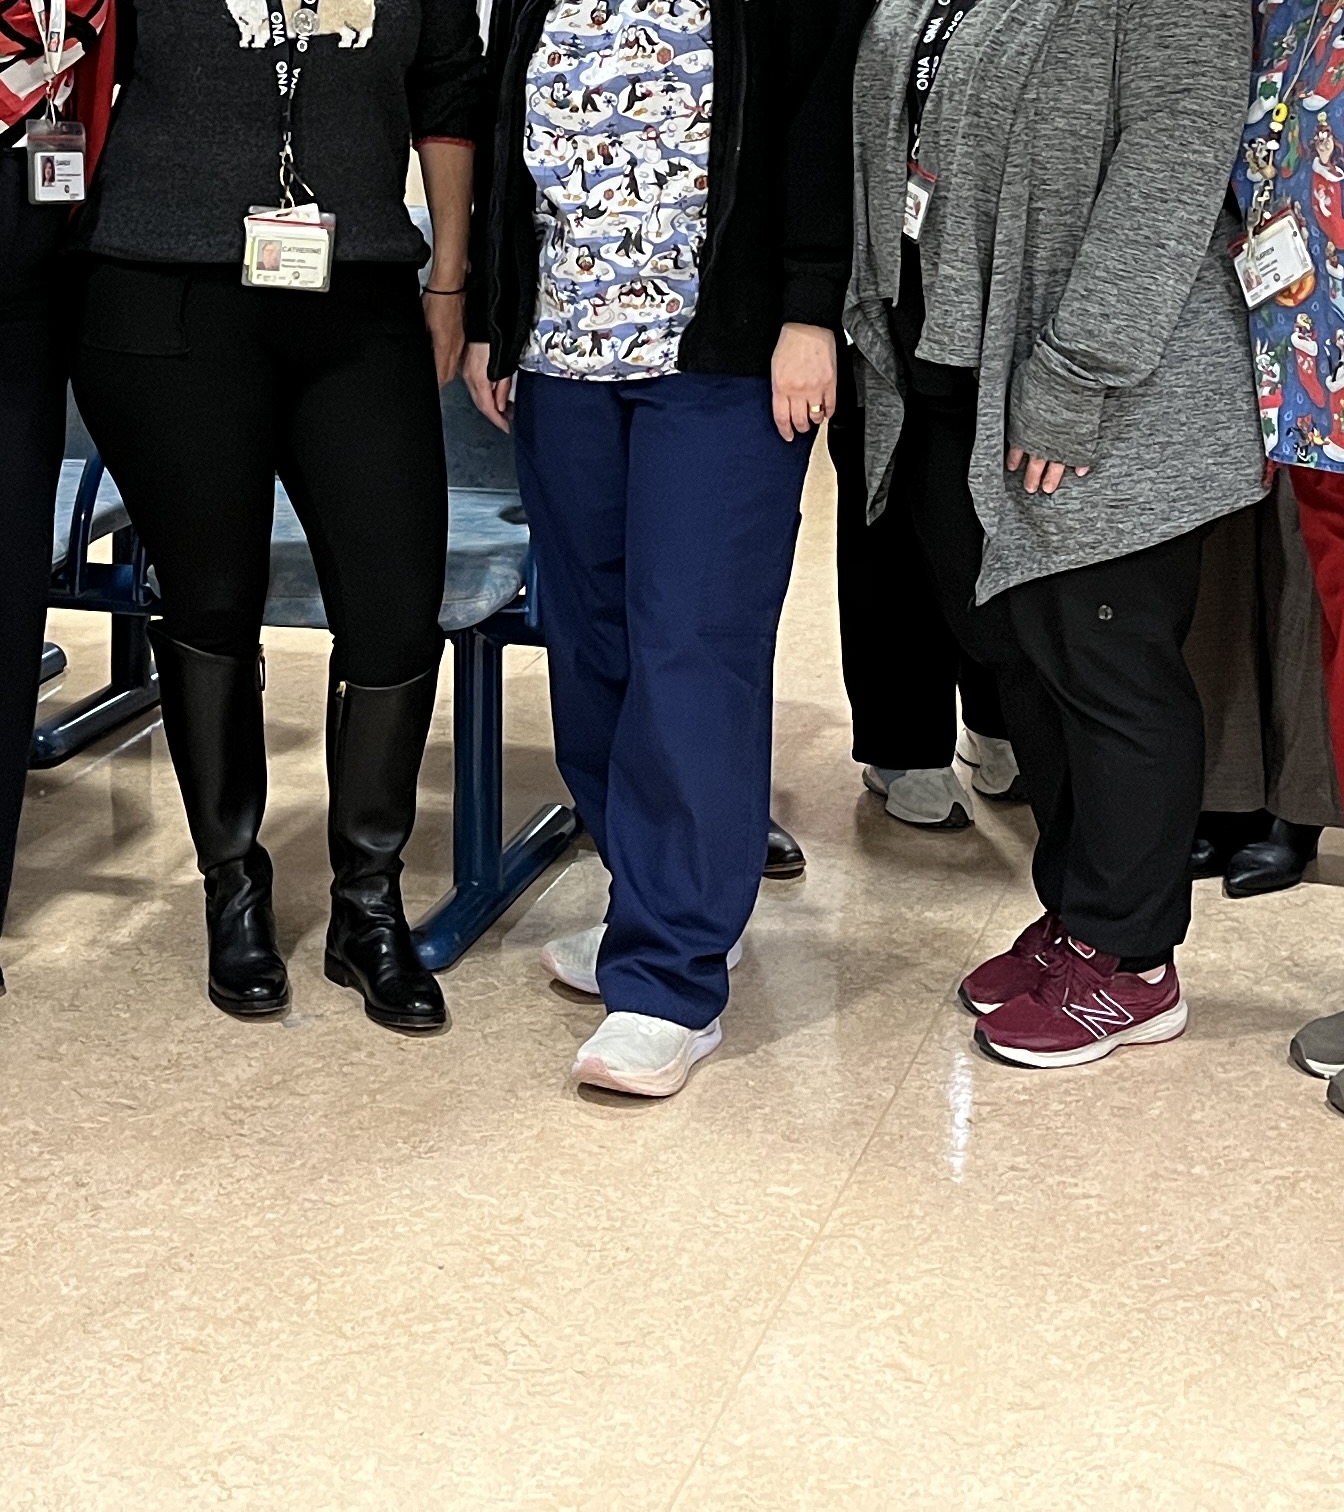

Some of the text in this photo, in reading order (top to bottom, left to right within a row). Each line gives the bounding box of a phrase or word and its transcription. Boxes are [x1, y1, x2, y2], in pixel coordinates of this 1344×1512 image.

[270, 11, 286, 47] ONA
[922, 17, 944, 44] ONA
[275, 61, 289, 96] ONA
[916, 56, 931, 91] ONA
